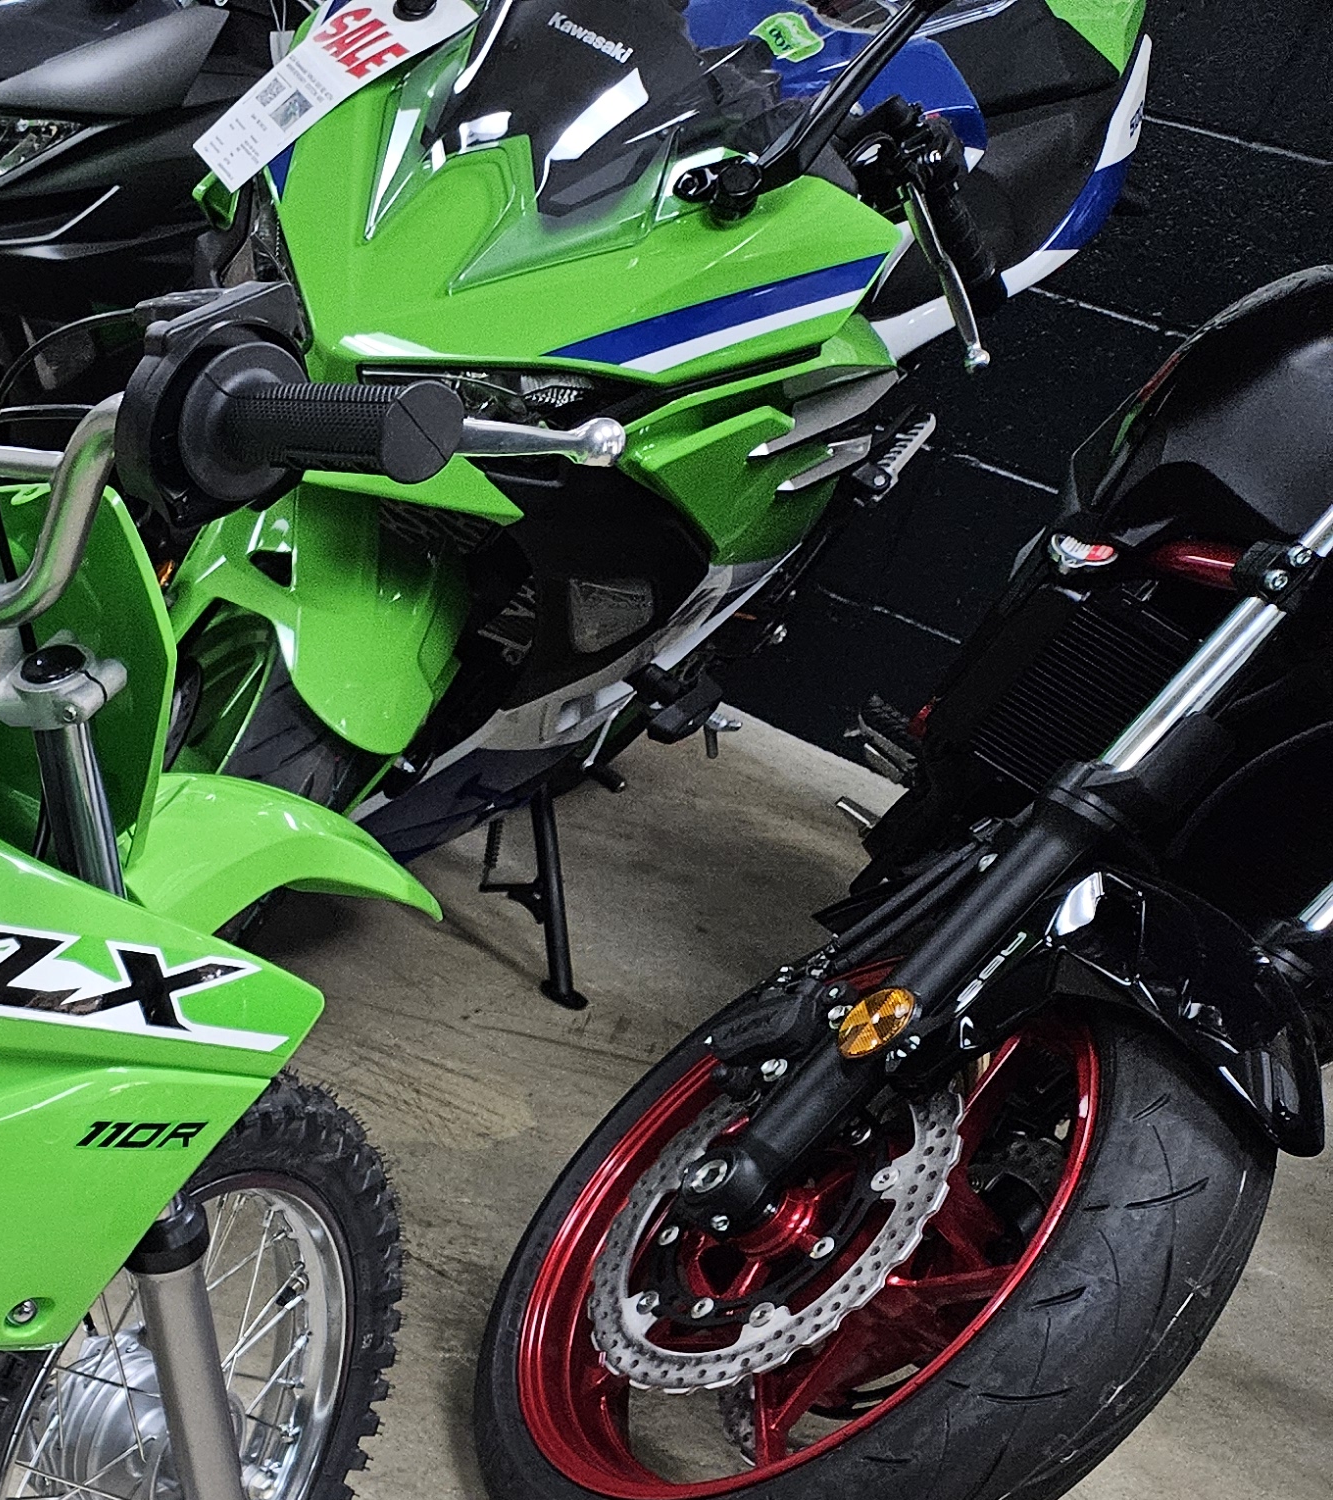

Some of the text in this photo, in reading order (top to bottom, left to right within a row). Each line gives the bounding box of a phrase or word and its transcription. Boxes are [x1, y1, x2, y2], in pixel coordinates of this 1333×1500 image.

[313, 8, 410, 79] SALE
[547, 11, 633, 64] Kawasaki
[76, 1121, 209, 1149] 110R
